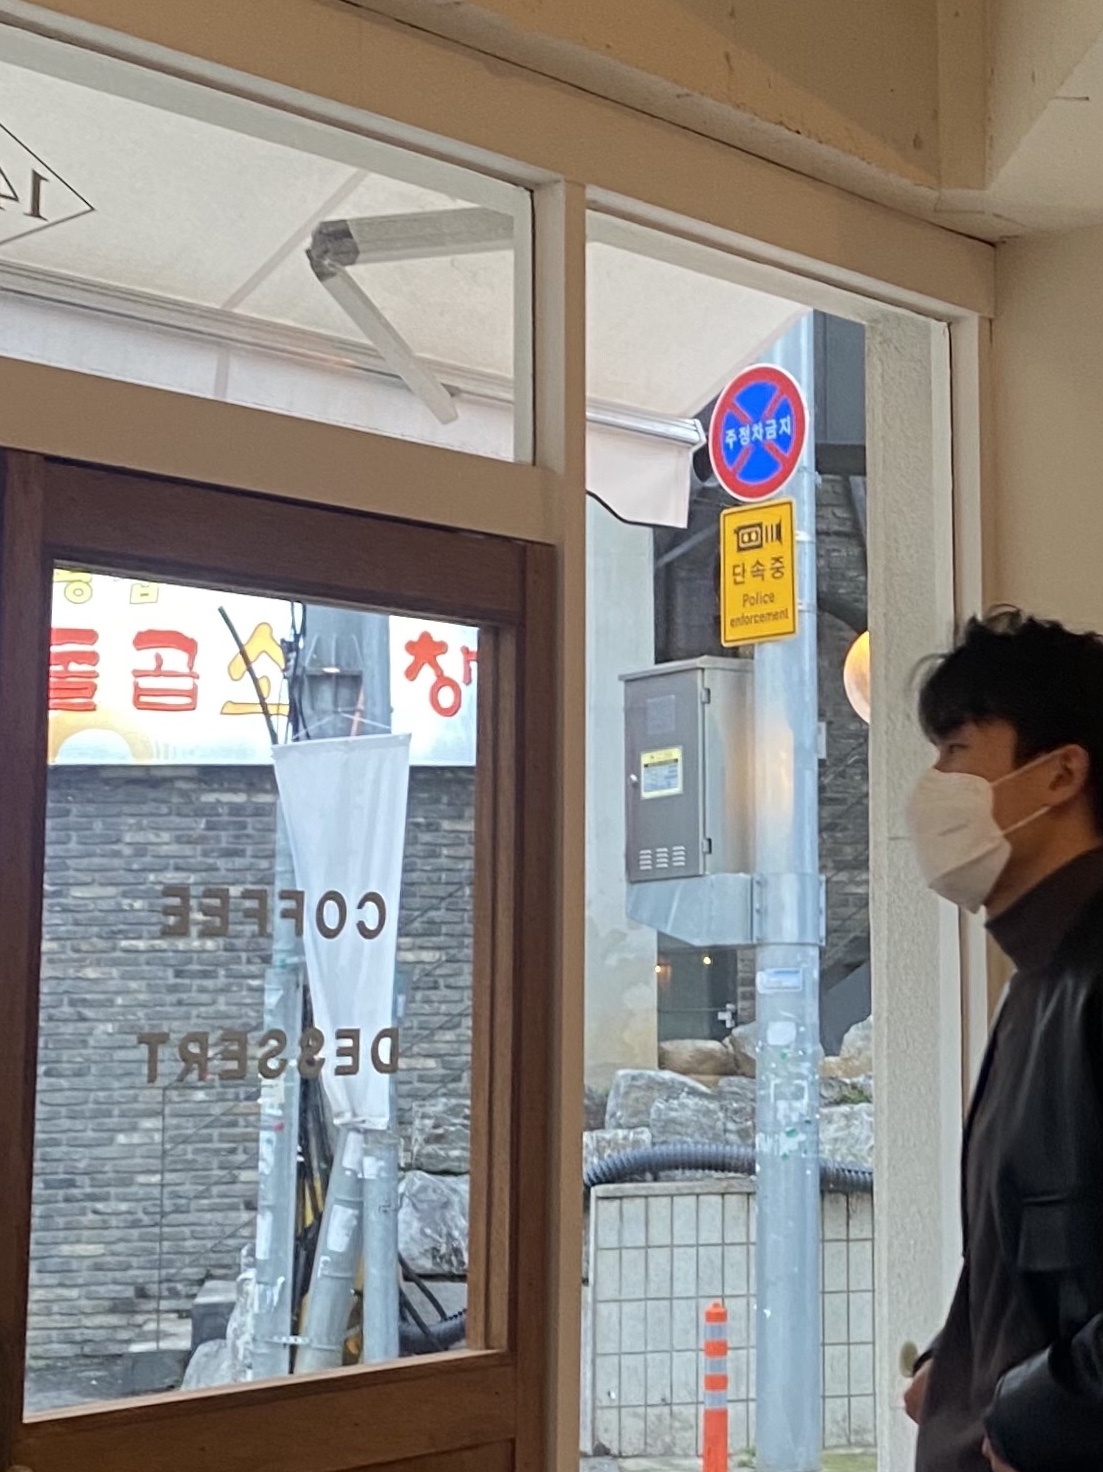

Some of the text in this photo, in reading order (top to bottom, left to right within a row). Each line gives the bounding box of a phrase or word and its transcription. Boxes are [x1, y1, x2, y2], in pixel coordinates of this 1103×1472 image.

[724, 414, 792, 450] 주정차금지
[732, 555, 786, 586] 단속중
[742, 591, 776, 608] Police
[729, 607, 790, 629] enforcement
